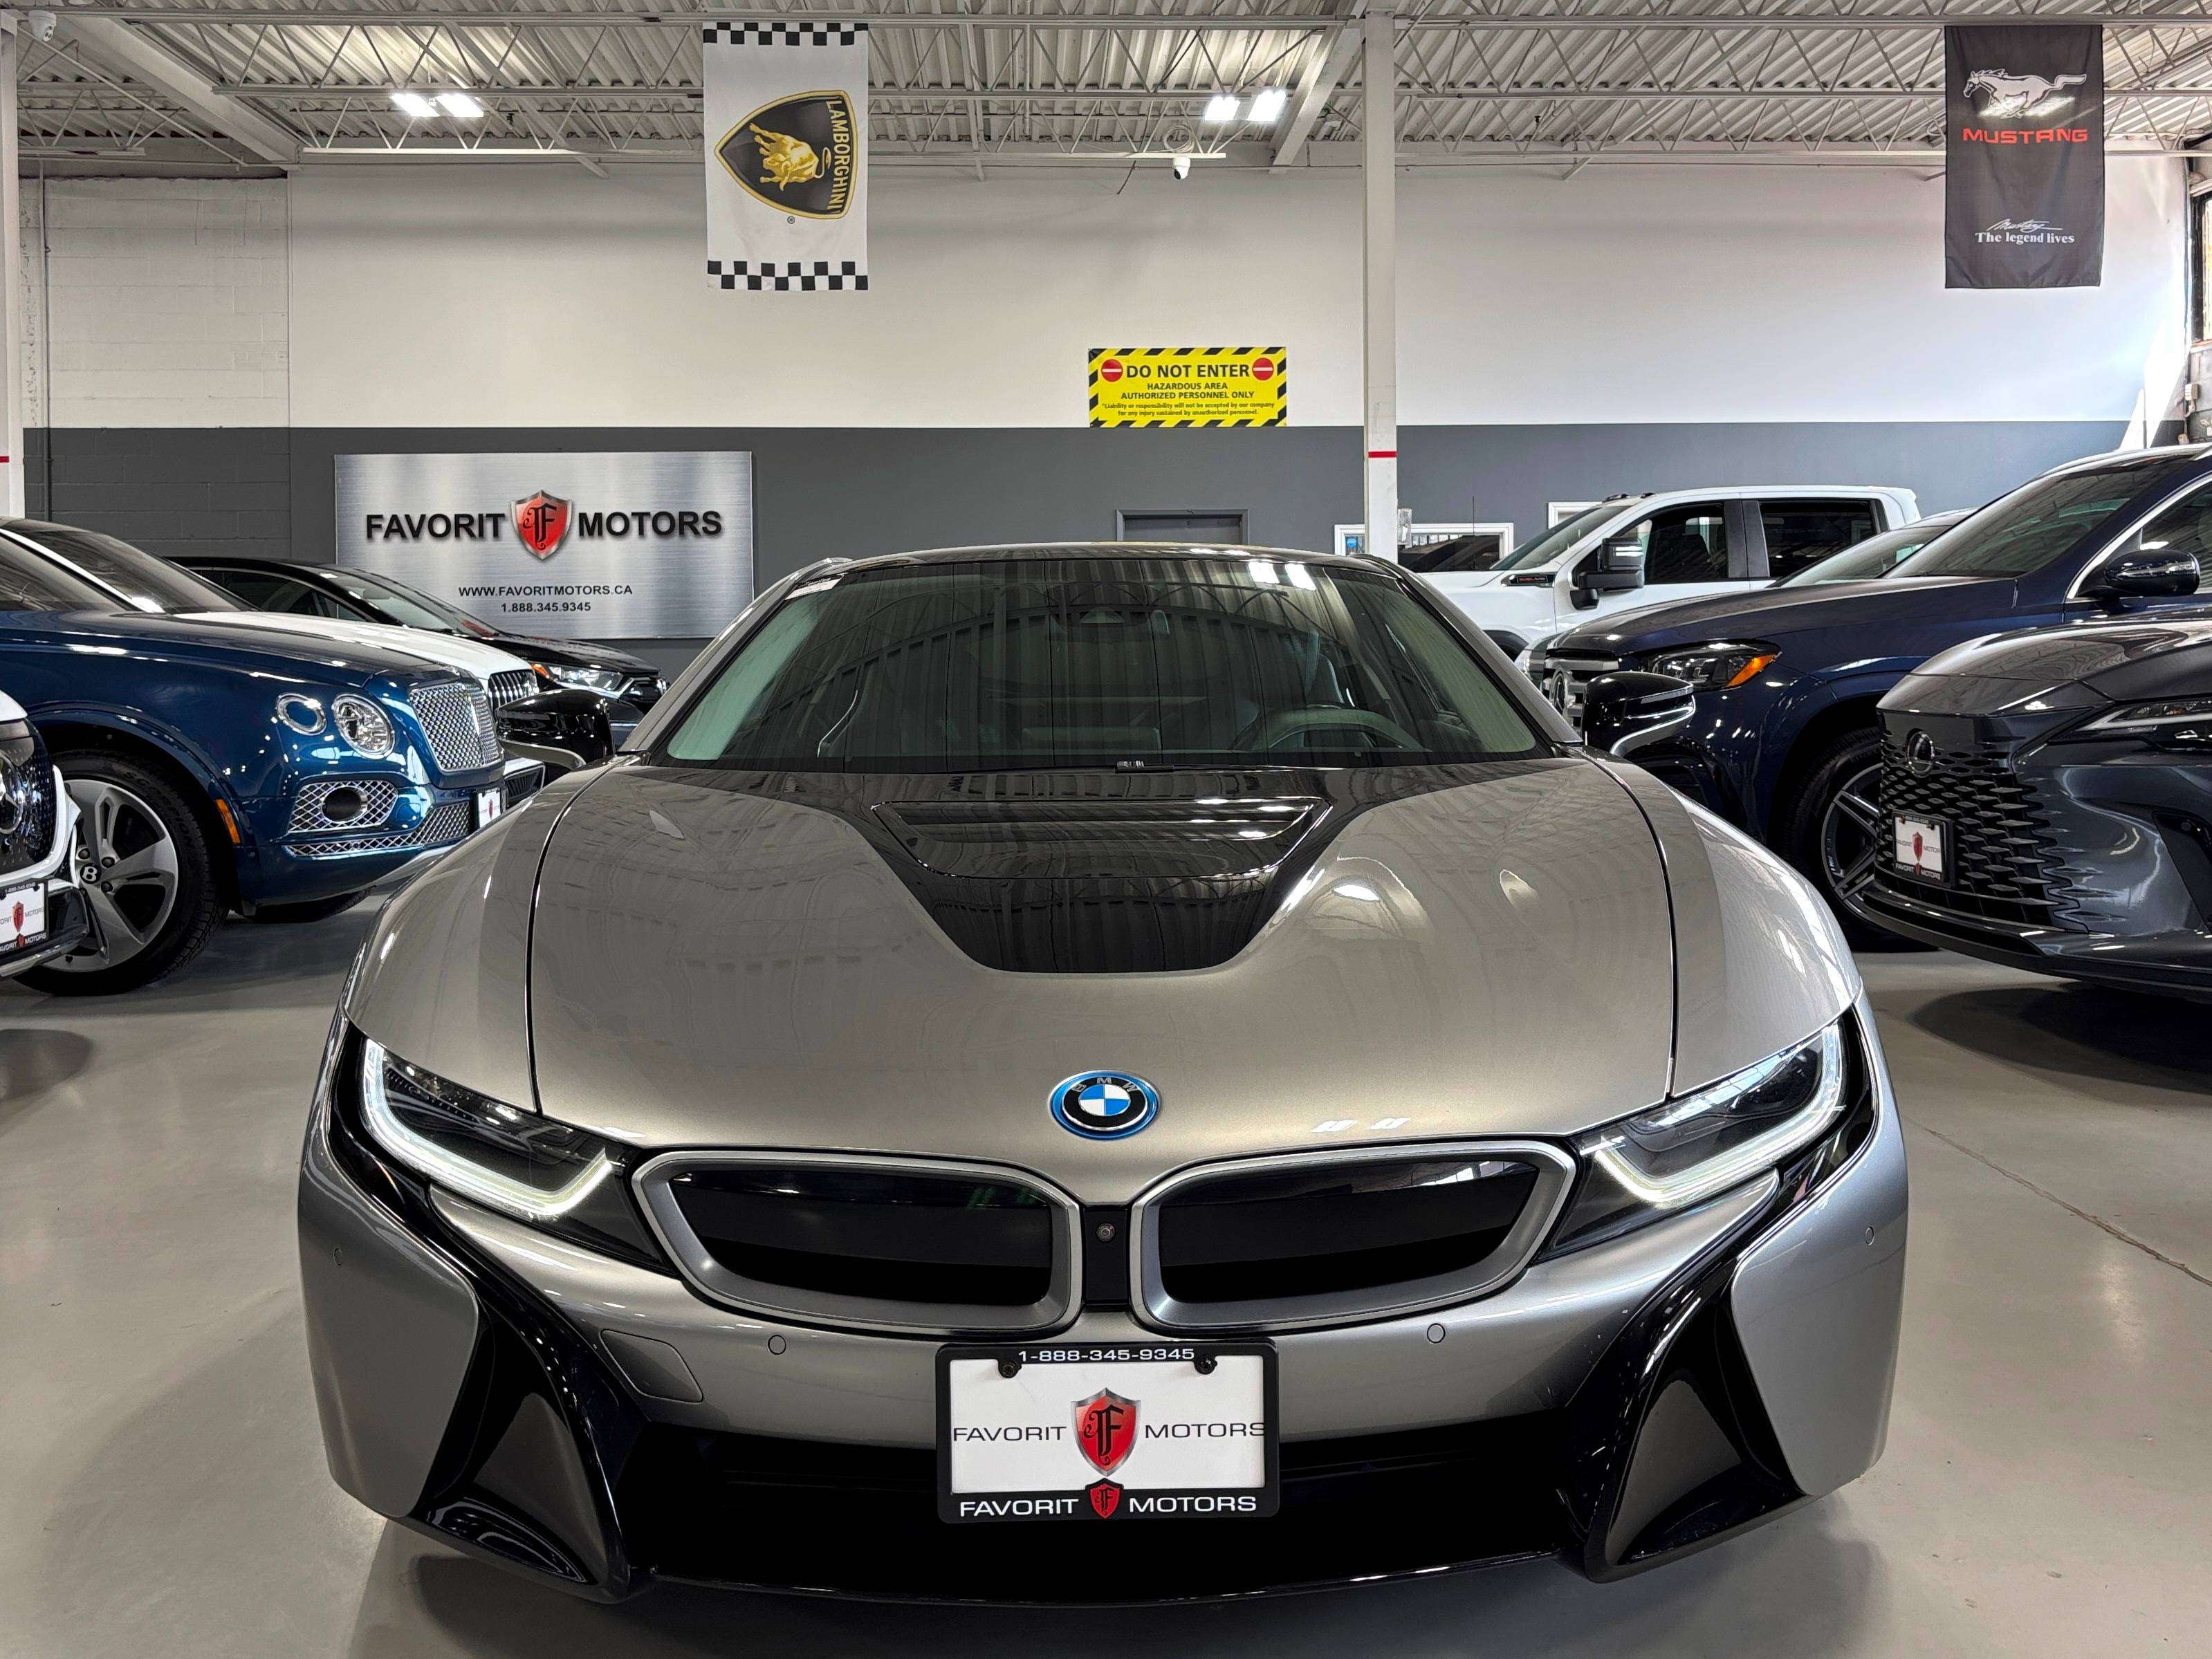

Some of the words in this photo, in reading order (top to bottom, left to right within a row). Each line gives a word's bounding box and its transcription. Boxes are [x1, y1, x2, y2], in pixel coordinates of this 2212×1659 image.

[1963, 128, 2088, 144] MUSTANG
[826, 100, 851, 210] LAMBORGHINI
[1975, 232, 2002, 243] The
[2006, 232, 2044, 245] legend
[2047, 232, 2075, 243] lives
[1126, 365, 1151, 378] DO
[1157, 364, 1191, 378] NOT
[1197, 364, 1249, 378] ENTER
[366, 513, 506, 539] FAVORIT
[578, 510, 722, 538] MOTORS
[459, 584, 633, 597] WWW.FAVORITMOTORS.CA
[501, 602, 591, 613] 1.888.345.9345
[82, 866, 98, 882] B
[1072, 1077, 1139, 1093] BMW
[1018, 1348, 1195, 1362] 1-888-345-9345
[953, 1426, 1067, 1441] FAVORIT
[1145, 1422, 1266, 1439] MOTORS
[960, 1499, 1079, 1517] FAVORIT
[1130, 1496, 1256, 1513] MOTORS
